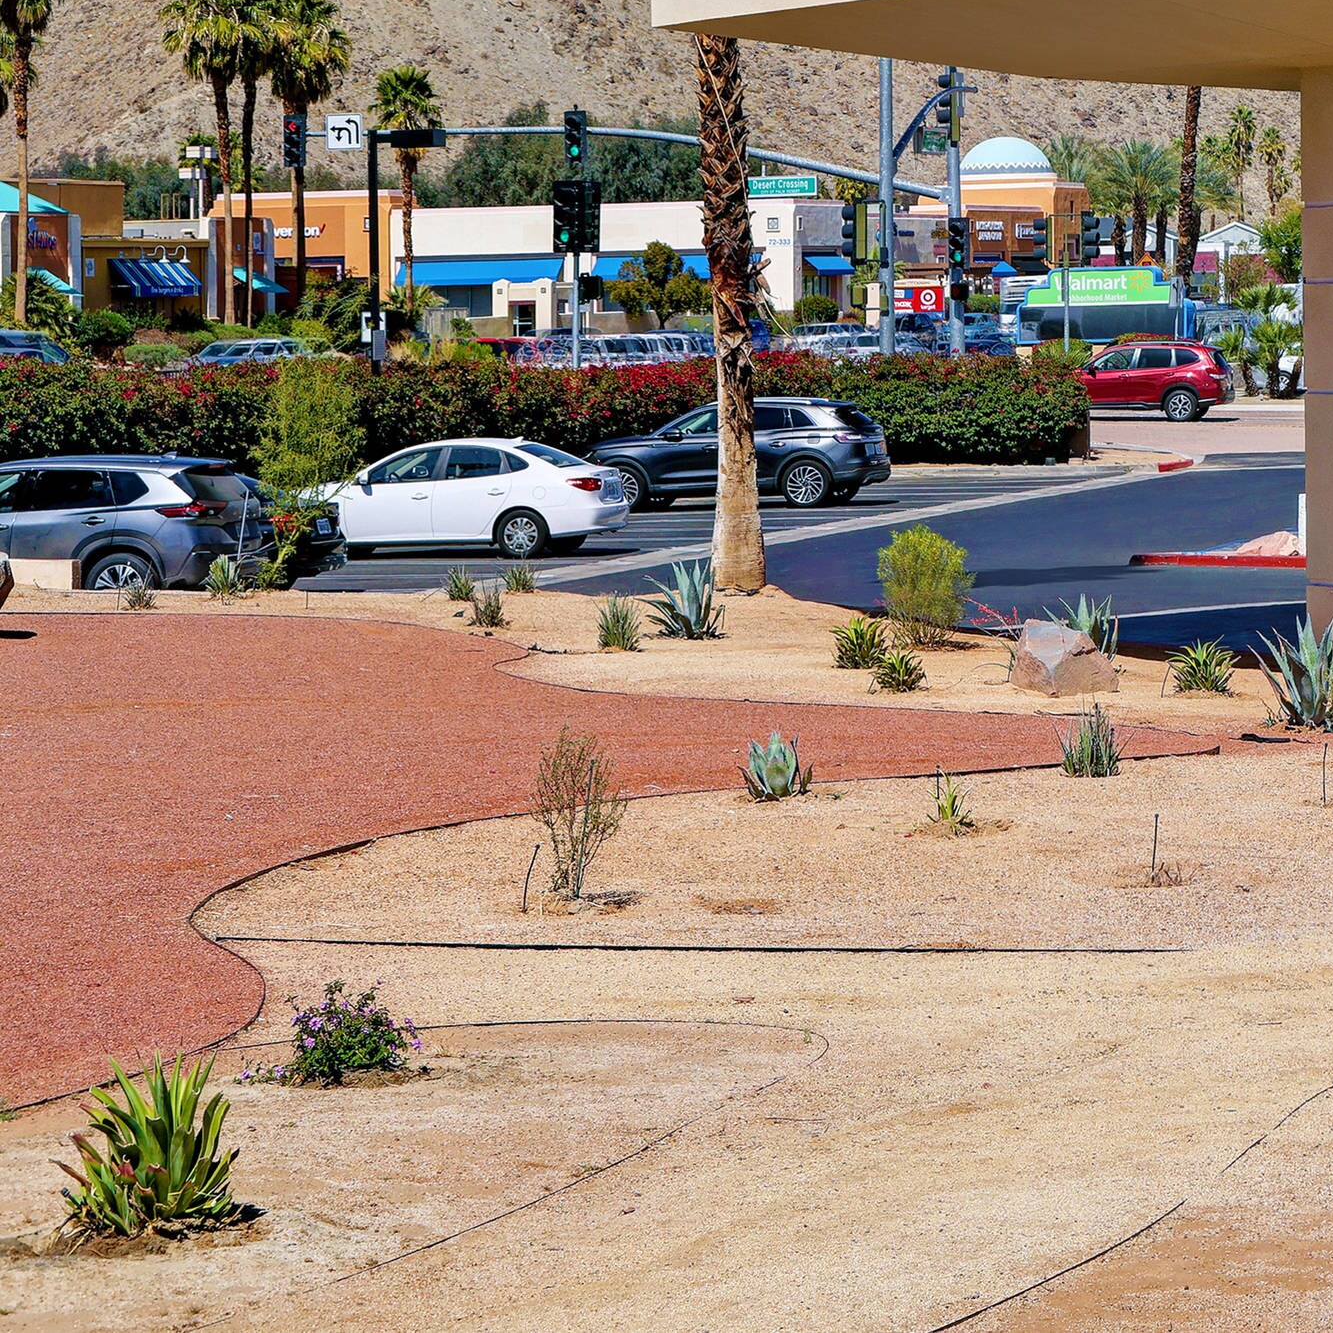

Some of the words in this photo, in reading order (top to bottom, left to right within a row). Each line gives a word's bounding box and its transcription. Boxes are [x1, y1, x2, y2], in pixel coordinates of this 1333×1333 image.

[752, 180, 776, 190] Desert
[778, 179, 808, 190] Crossing
[274, 226, 320, 237] veron
